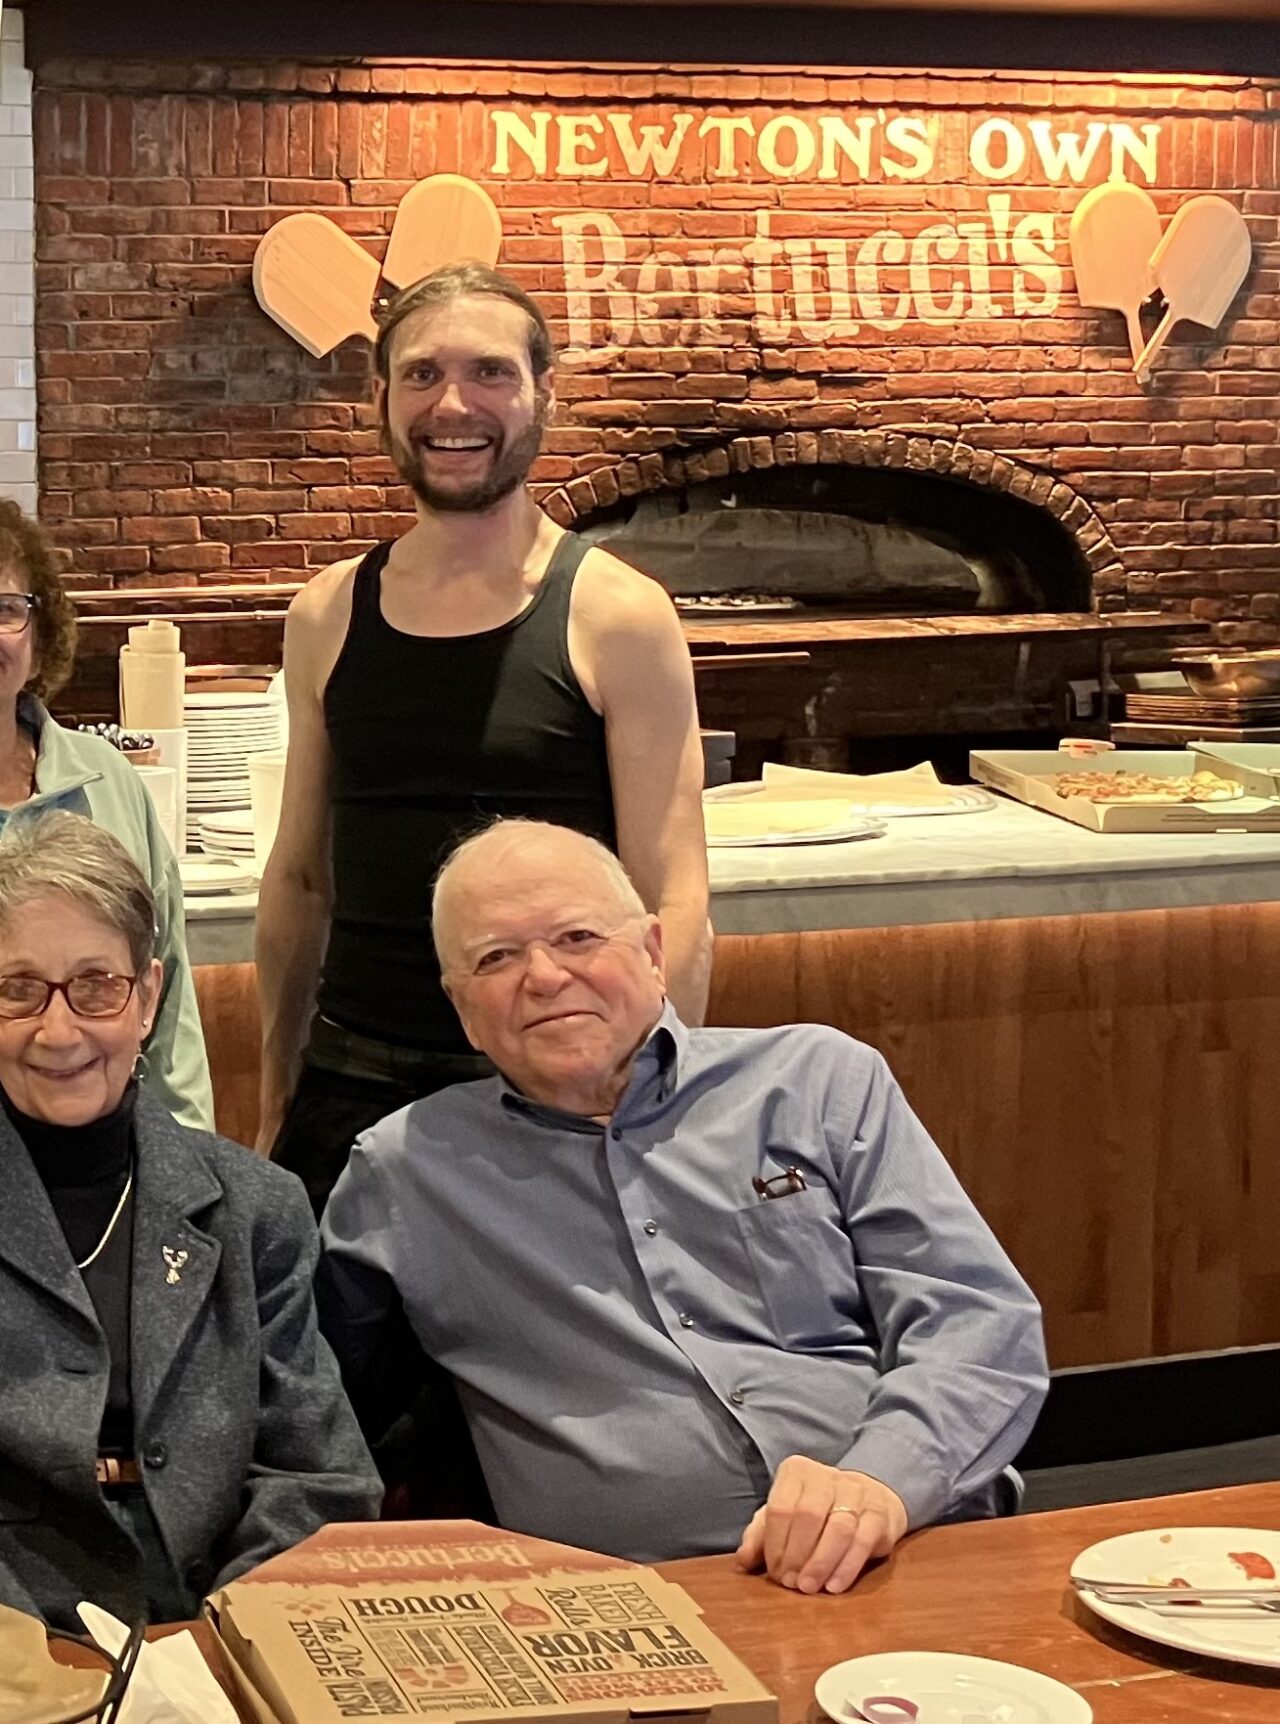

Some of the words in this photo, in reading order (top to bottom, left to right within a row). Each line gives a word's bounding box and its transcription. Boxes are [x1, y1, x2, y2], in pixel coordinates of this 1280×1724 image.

[490, 108, 929, 180] NEWTON'S
[969, 117, 1162, 185] OWN
[552, 193, 1062, 366] Bertucci's
[320, 1540, 533, 1572] Bertucci's
[350, 1593, 481, 1616] DOUGH
[544, 1587, 591, 1626] Rolls
[575, 1583, 633, 1623] BAKED
[607, 1582, 667, 1620] FRESH
[312, 1616, 351, 1643] The
[523, 1625, 692, 1656] FLAVOR
[288, 1620, 341, 1677] INSIDE
[544, 1656, 613, 1674] OVEN
[630, 1649, 709, 1668] BRICK
[325, 1682, 379, 1716] PASTA
